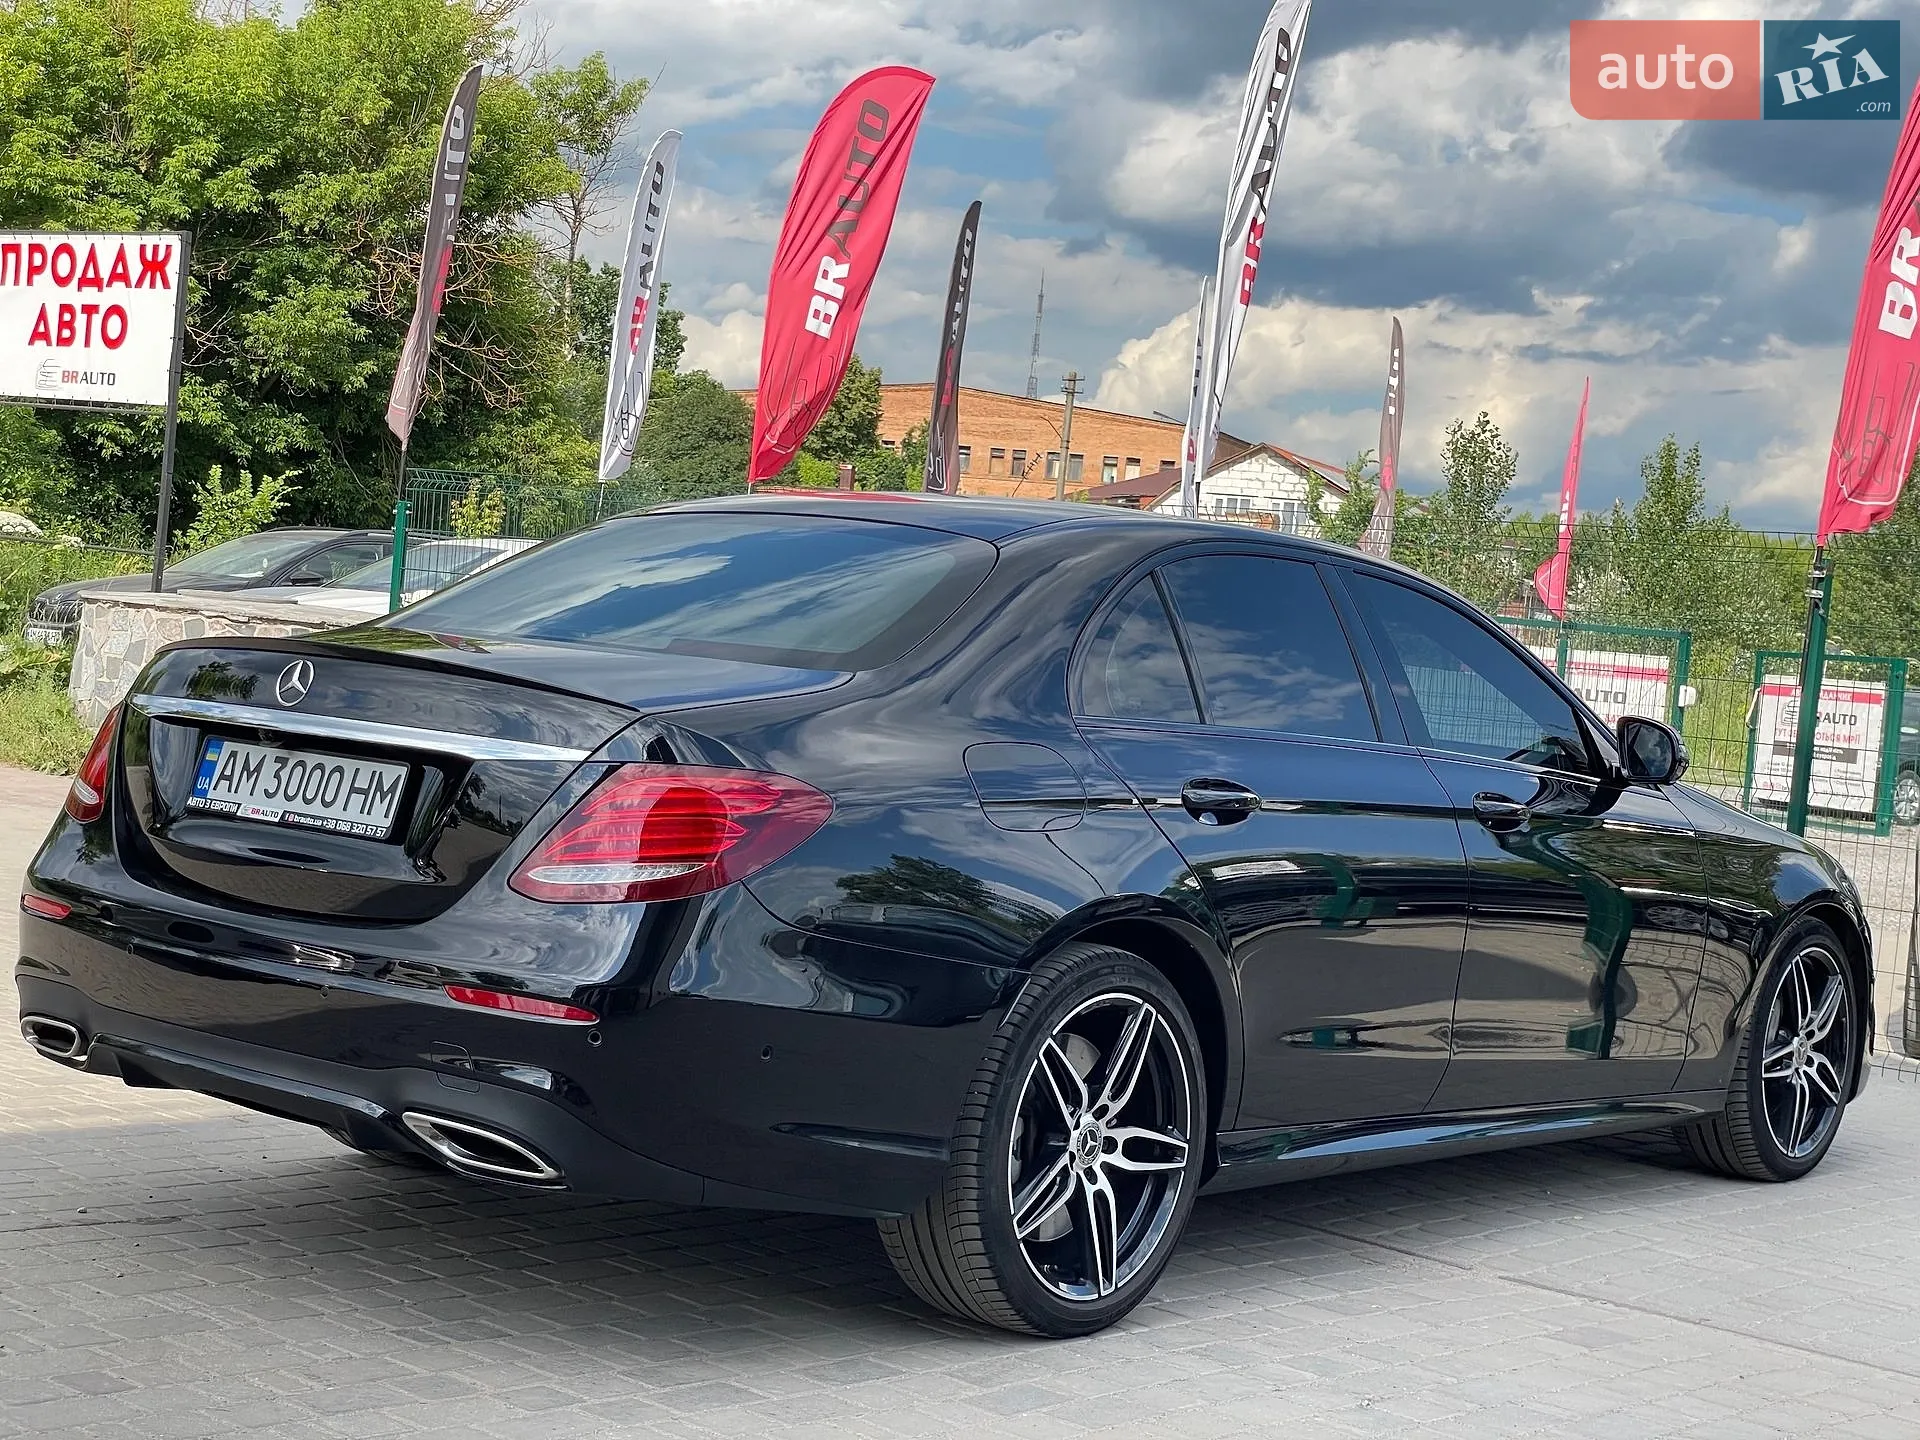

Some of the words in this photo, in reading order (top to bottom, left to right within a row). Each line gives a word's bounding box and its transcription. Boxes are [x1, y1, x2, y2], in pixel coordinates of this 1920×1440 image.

[805, 98, 890, 340] BRAUTO
[0, 242, 173, 293] ПРОДАЖ
[1878, 200, 1920, 340] BR
[28, 302, 129, 350] АВТО
[61, 369, 116, 386] BRAUTO
[1572, 687, 1628, 704] AUTO
[197, 776, 209, 790] UA
[212, 750, 267, 797] AM
[263, 756, 345, 809] 3000
[342, 767, 402, 819] HM
[186, 796, 205, 808] АВТО
[250, 807, 279, 819] BRAUTO
[323, 818, 336, 829] +38
[351, 823, 366, 834] 320
[365, 825, 377, 836] 57
[375, 827, 387, 838] 57
